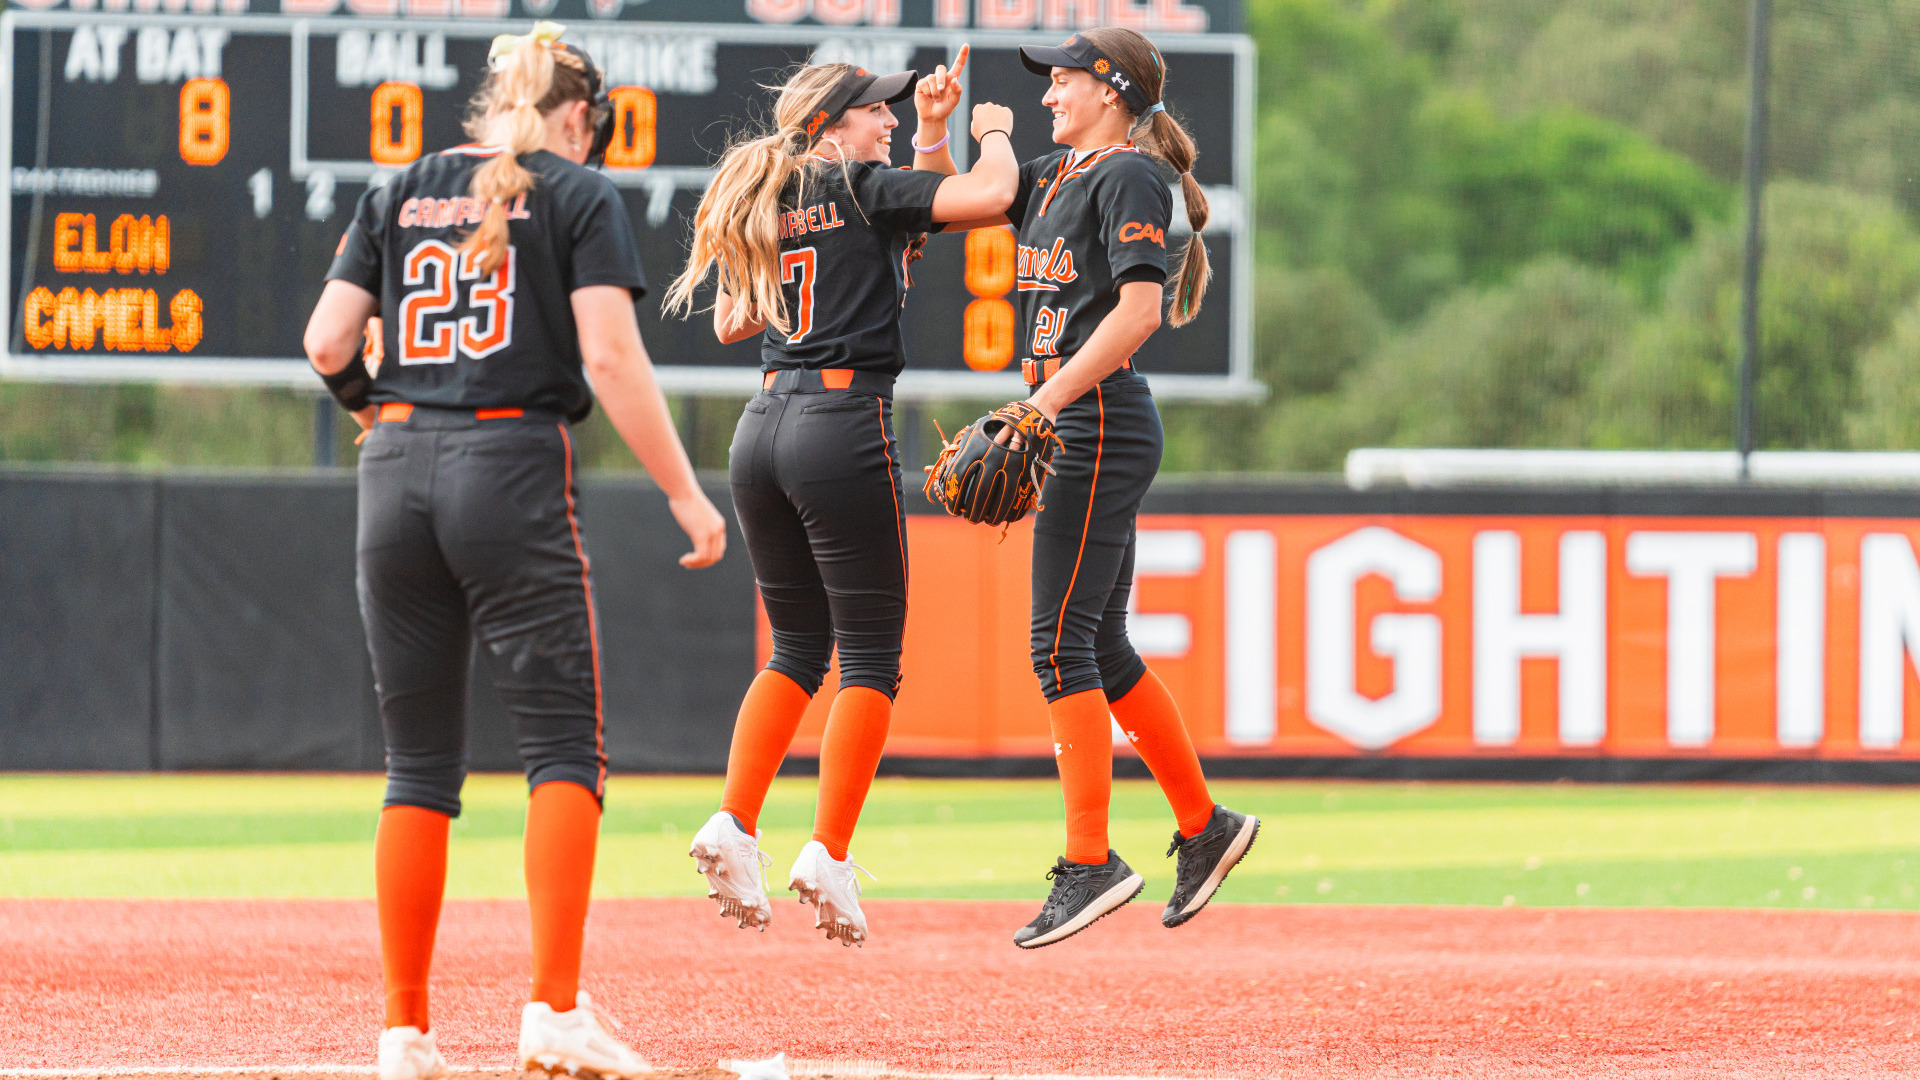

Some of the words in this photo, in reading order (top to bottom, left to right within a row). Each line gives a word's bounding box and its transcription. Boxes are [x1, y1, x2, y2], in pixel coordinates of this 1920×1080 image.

[64, 25, 127, 83] AT
[136, 25, 232, 84] BAT
[336, 29, 458, 89] BALL
[179, 76, 230, 166] 8
[370, 81, 423, 165] 0
[248, 167, 272, 219] 1
[305, 169, 336, 221] 2
[643, 176, 676, 228] 7
[398, 193, 531, 228] CAMPBLL
[777, 201, 845, 240] MPBELL
[54, 212, 170, 275] ELON
[1018, 236, 1078, 284] mels
[1118, 221, 1165, 249] CAA
[24, 286, 203, 352] CAMELS
[399, 238, 516, 366] 23
[780, 246, 818, 345] 7
[1033, 305, 1068, 356] 21
